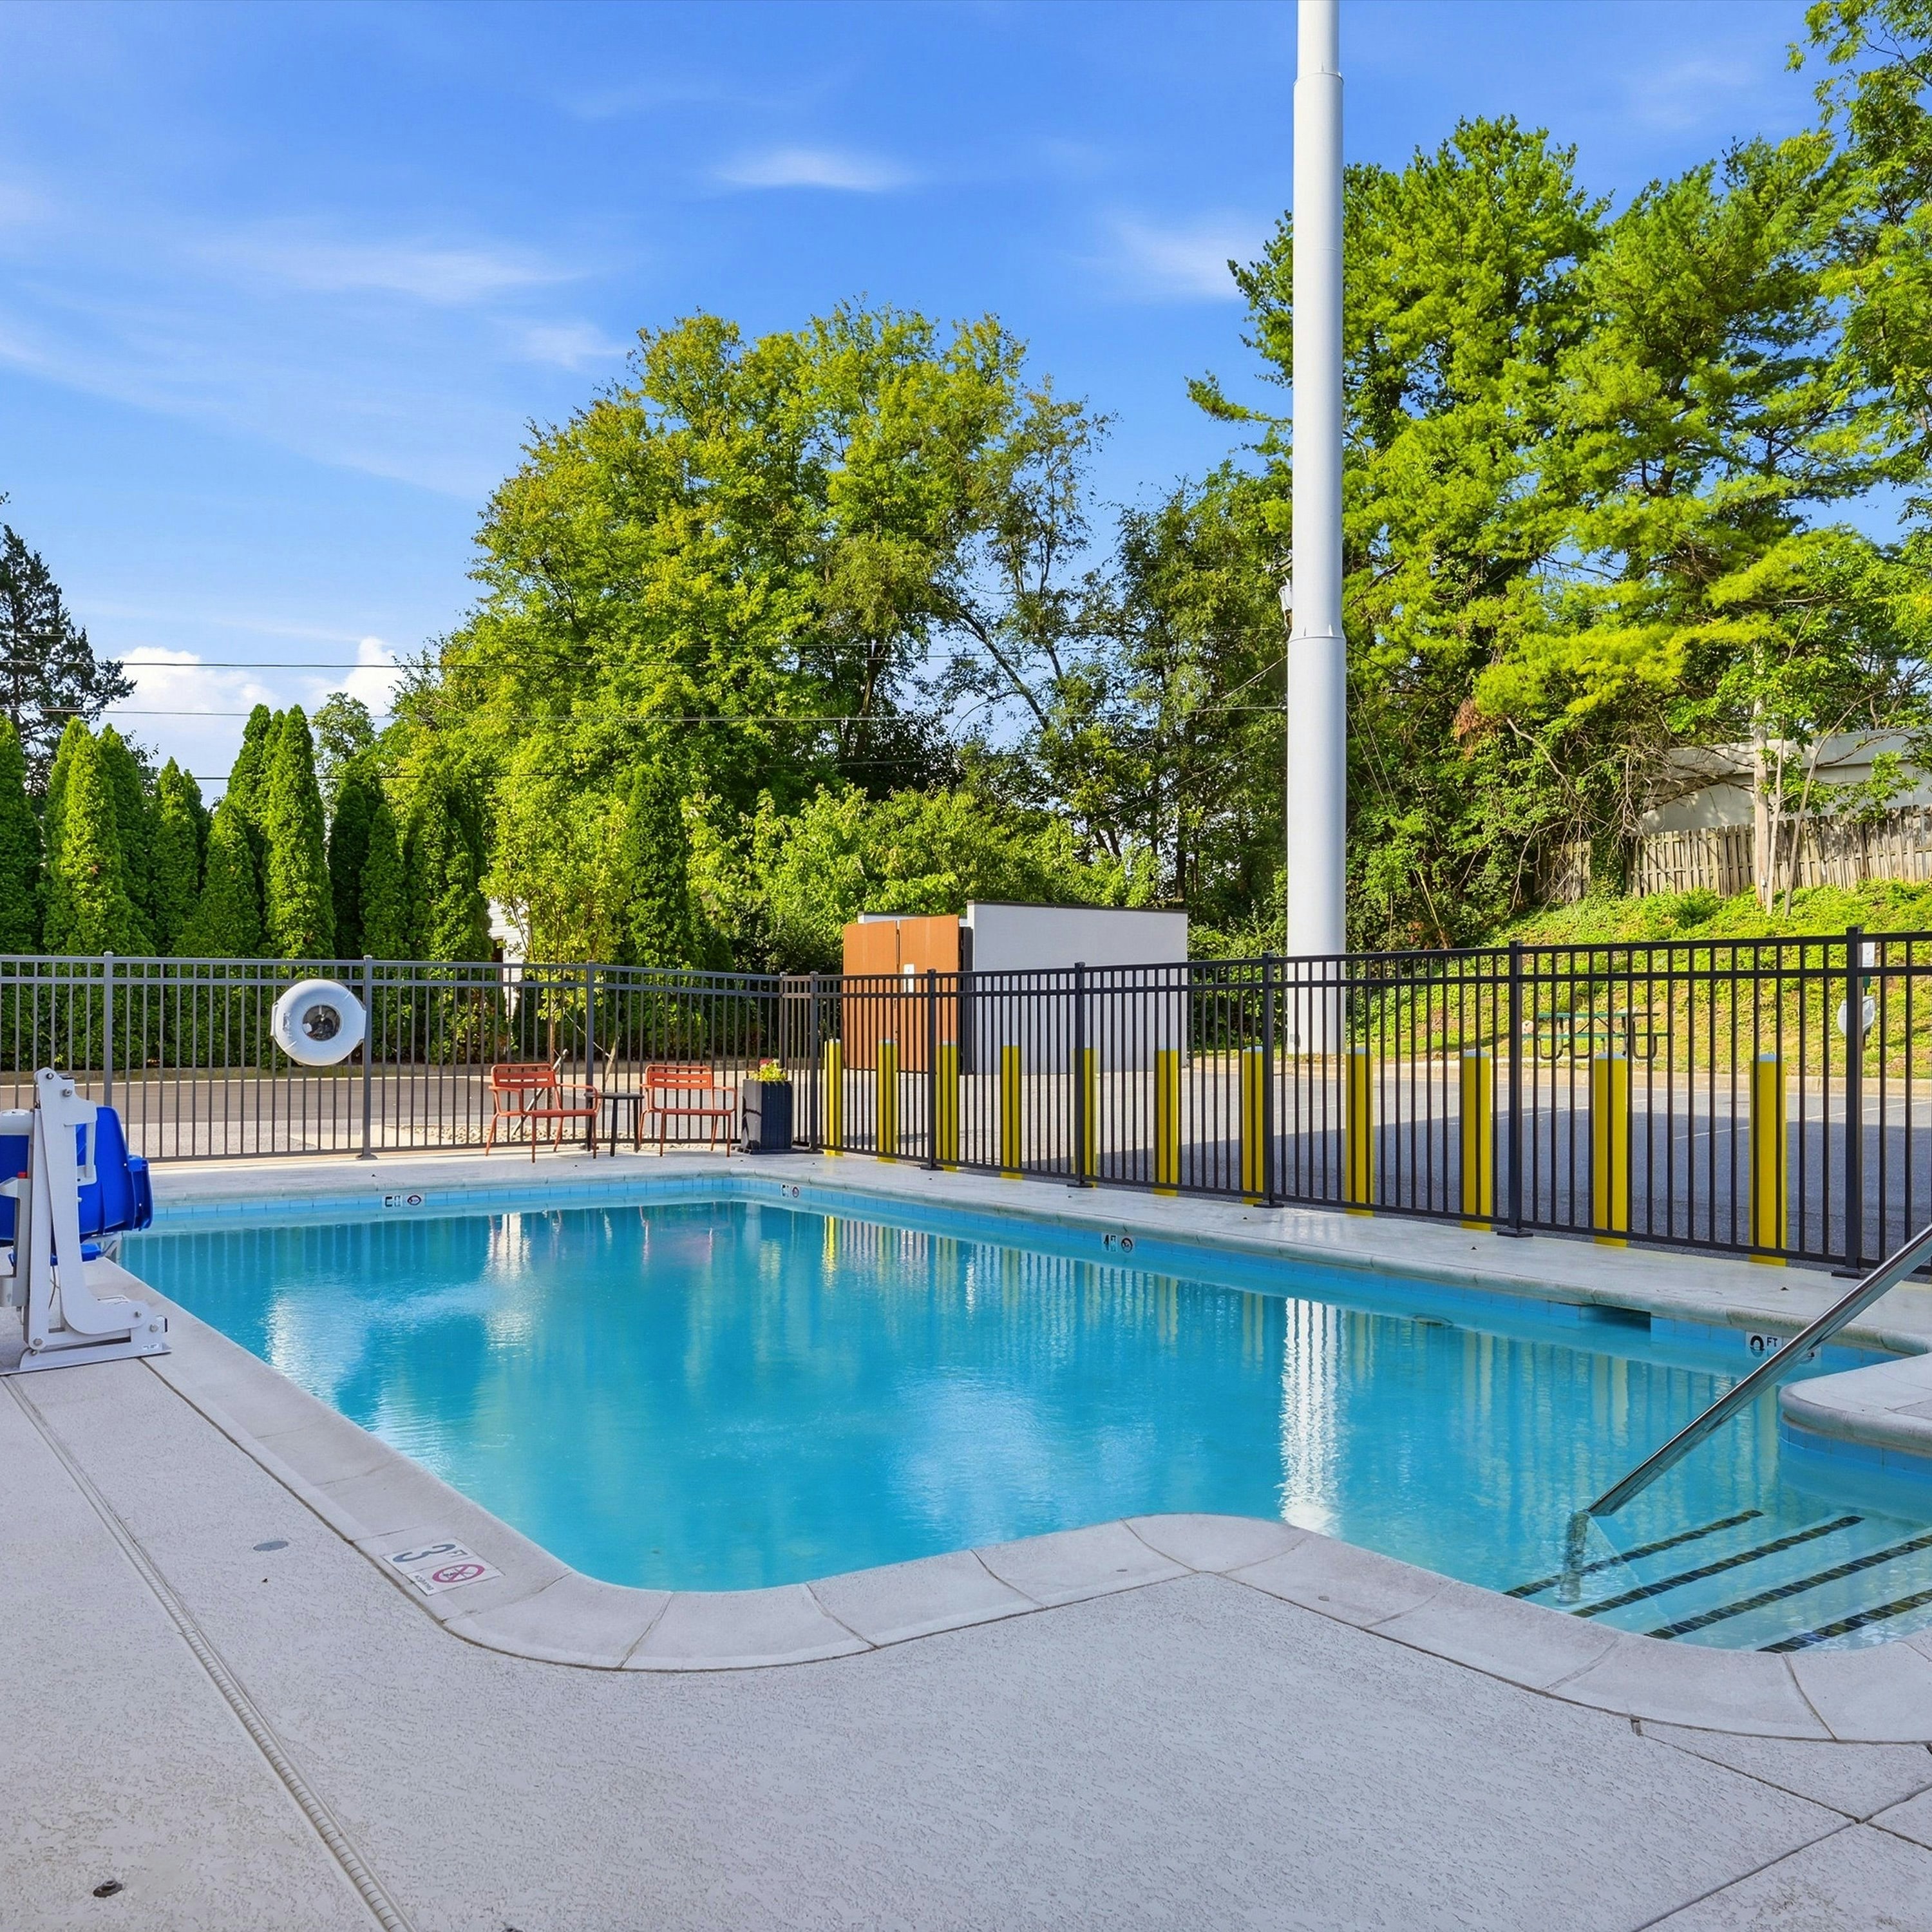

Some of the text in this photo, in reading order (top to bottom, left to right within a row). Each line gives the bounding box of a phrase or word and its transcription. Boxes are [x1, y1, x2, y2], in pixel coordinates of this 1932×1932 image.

[1766, 1337, 1777, 1347] FT
[392, 1544, 468, 1562] 3 FT
